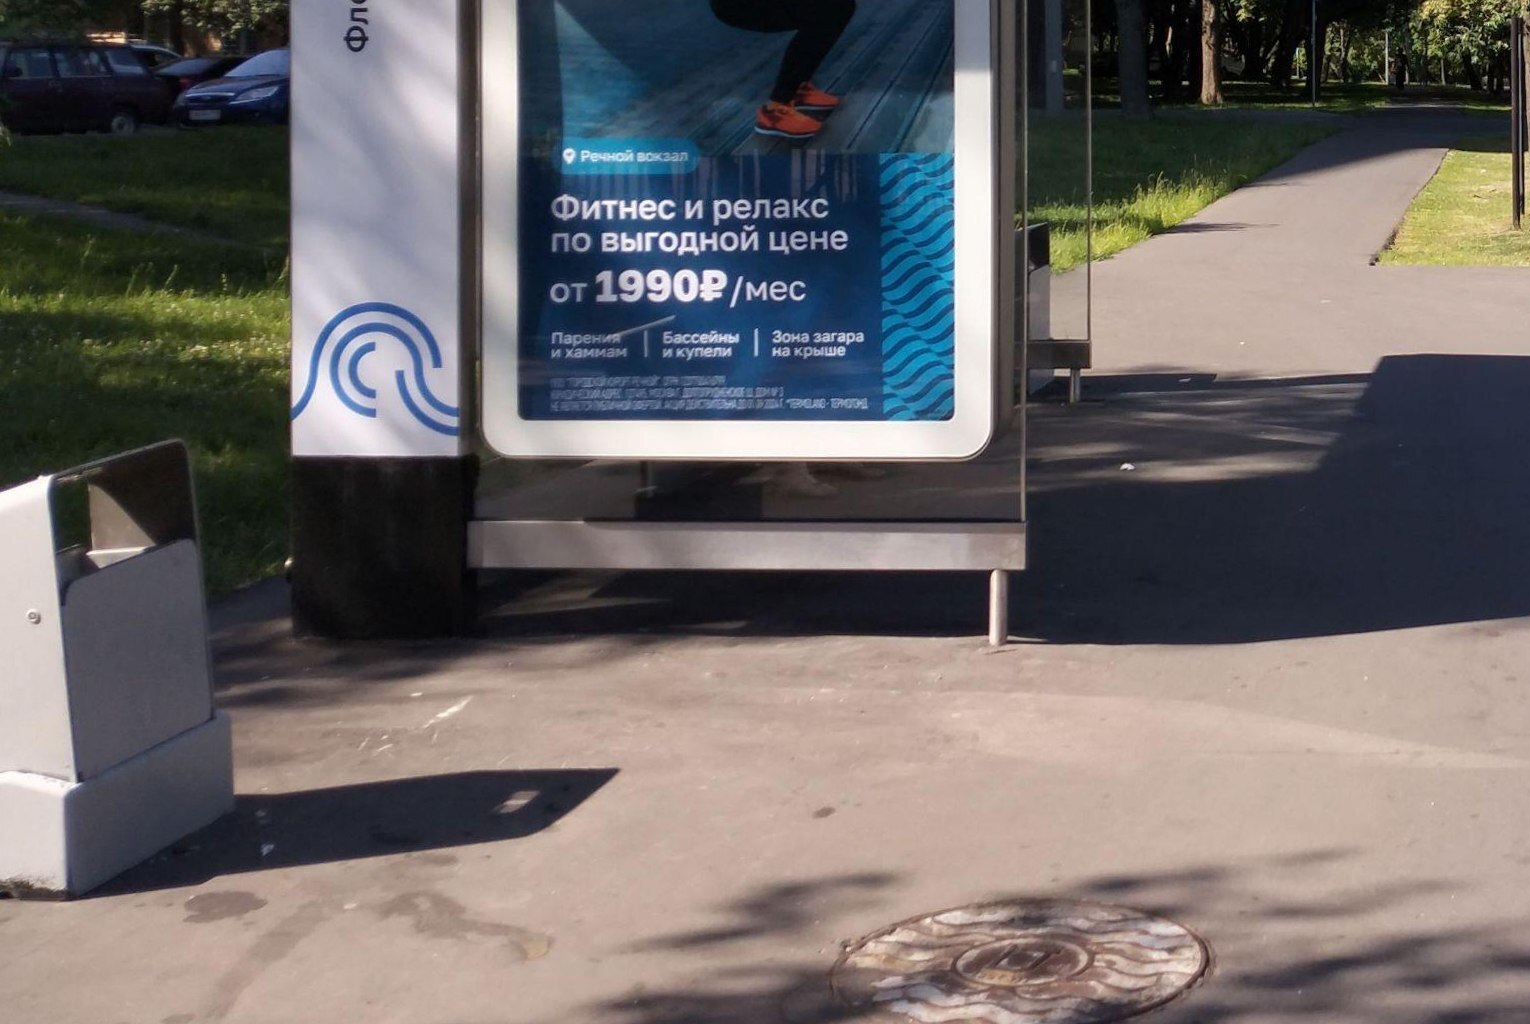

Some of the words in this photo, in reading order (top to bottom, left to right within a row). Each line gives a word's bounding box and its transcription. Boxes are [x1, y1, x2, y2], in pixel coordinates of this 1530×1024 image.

[580, 149, 635, 163] Речной
[636, 151, 689, 163] вокзал
[550, 193, 677, 222] Фитнес
[684, 199, 704, 220] и
[712, 197, 830, 226] релакс
[551, 231, 592, 253] по
[601, 224, 760, 257] выгодной
[768, 229, 849, 256] цене
[549, 281, 588, 304] от
[551, 331, 622, 347] Парения
[662, 330, 740, 345] Бассейны
[771, 329, 811, 344] Зона
[812, 331, 866, 346] загара
[551, 347, 562, 359] и
[564, 347, 629, 360] хаммам
[662, 346, 674, 359] и
[676, 346, 733, 362] купели
[771, 345, 791, 358] на
[793, 344, 847, 360] крыше
